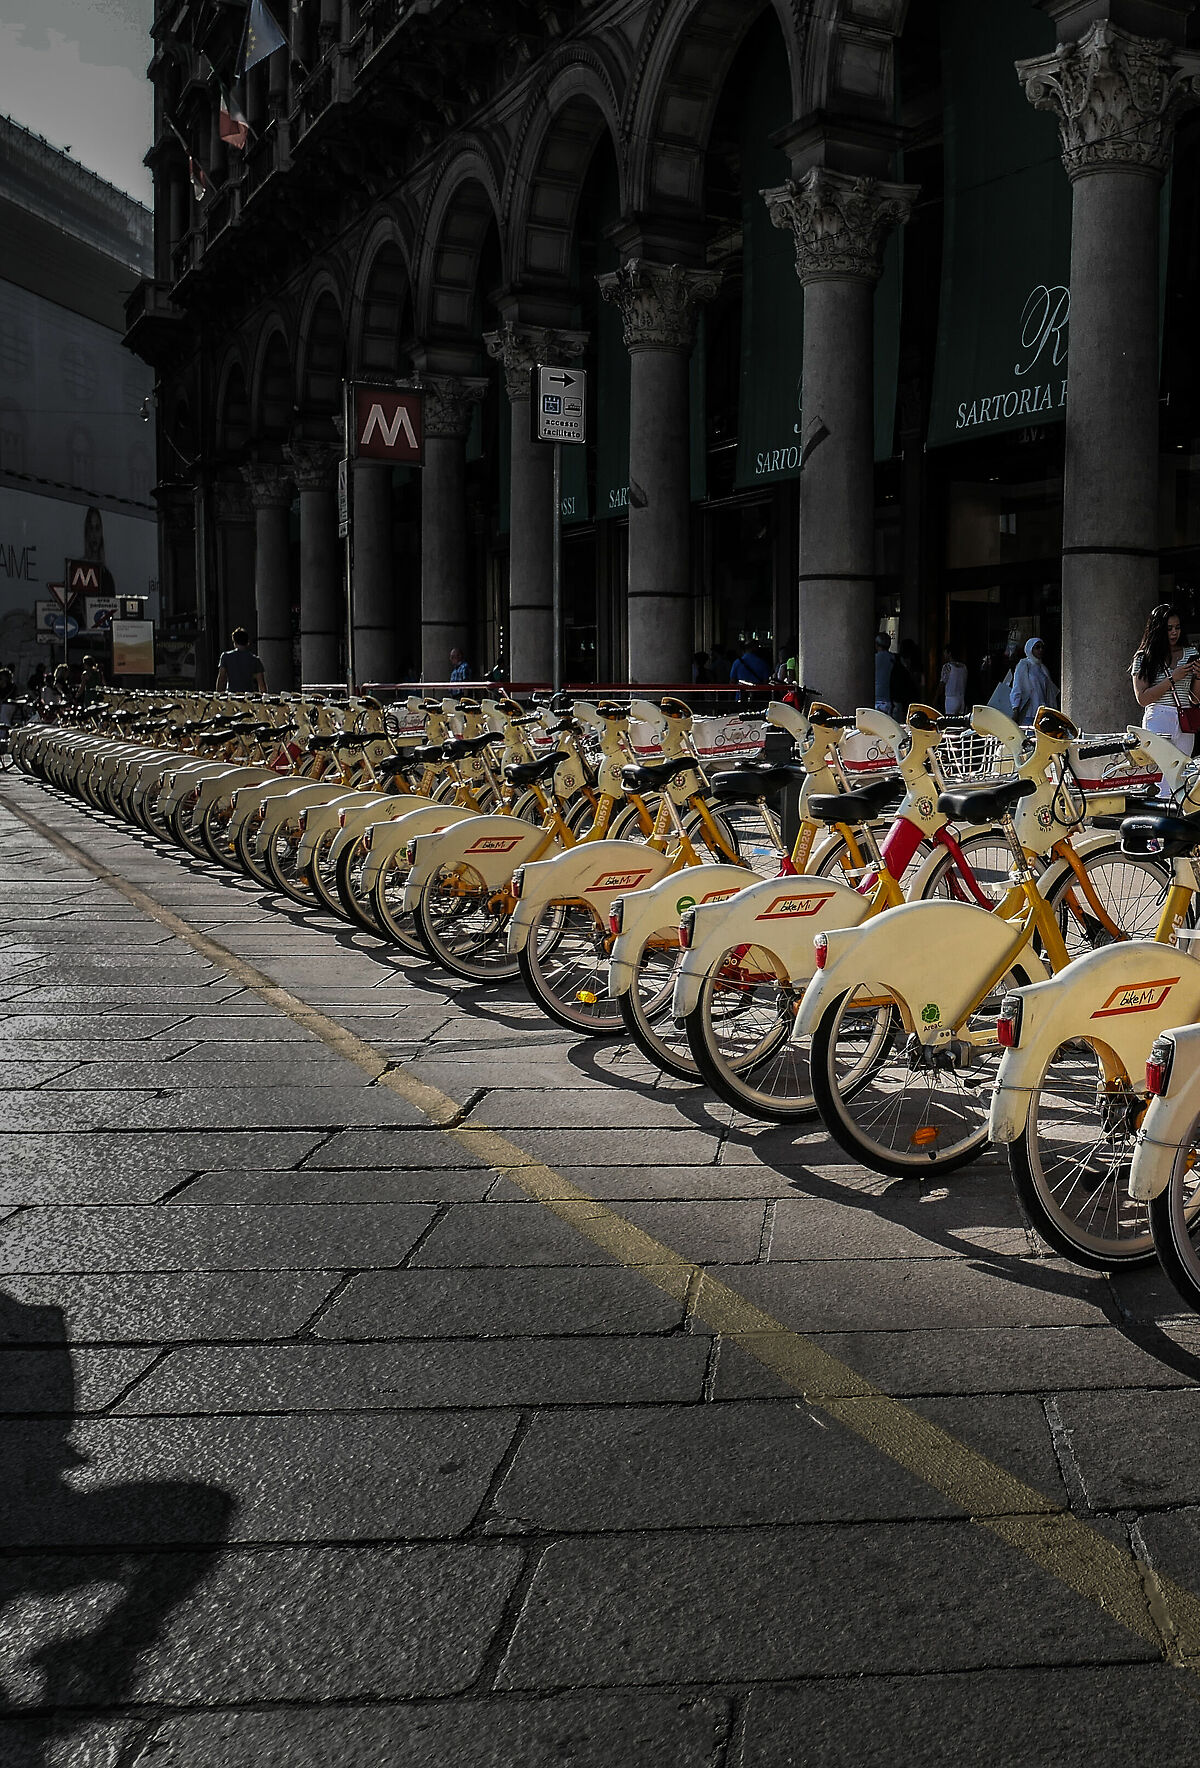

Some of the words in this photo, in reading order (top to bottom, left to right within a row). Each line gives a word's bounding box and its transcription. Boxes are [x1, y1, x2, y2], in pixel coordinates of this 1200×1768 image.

[955, 383, 1053, 429] SARTORIA
[360, 403, 419, 448] M
[543, 427, 581, 438] facilitato
[545, 418, 579, 428] accesso
[71, 567, 99, 588] M
[795, 828, 812, 864] 20828
[780, 899, 811, 912] bikeMi
[1120, 988, 1155, 1006] bikeMi
